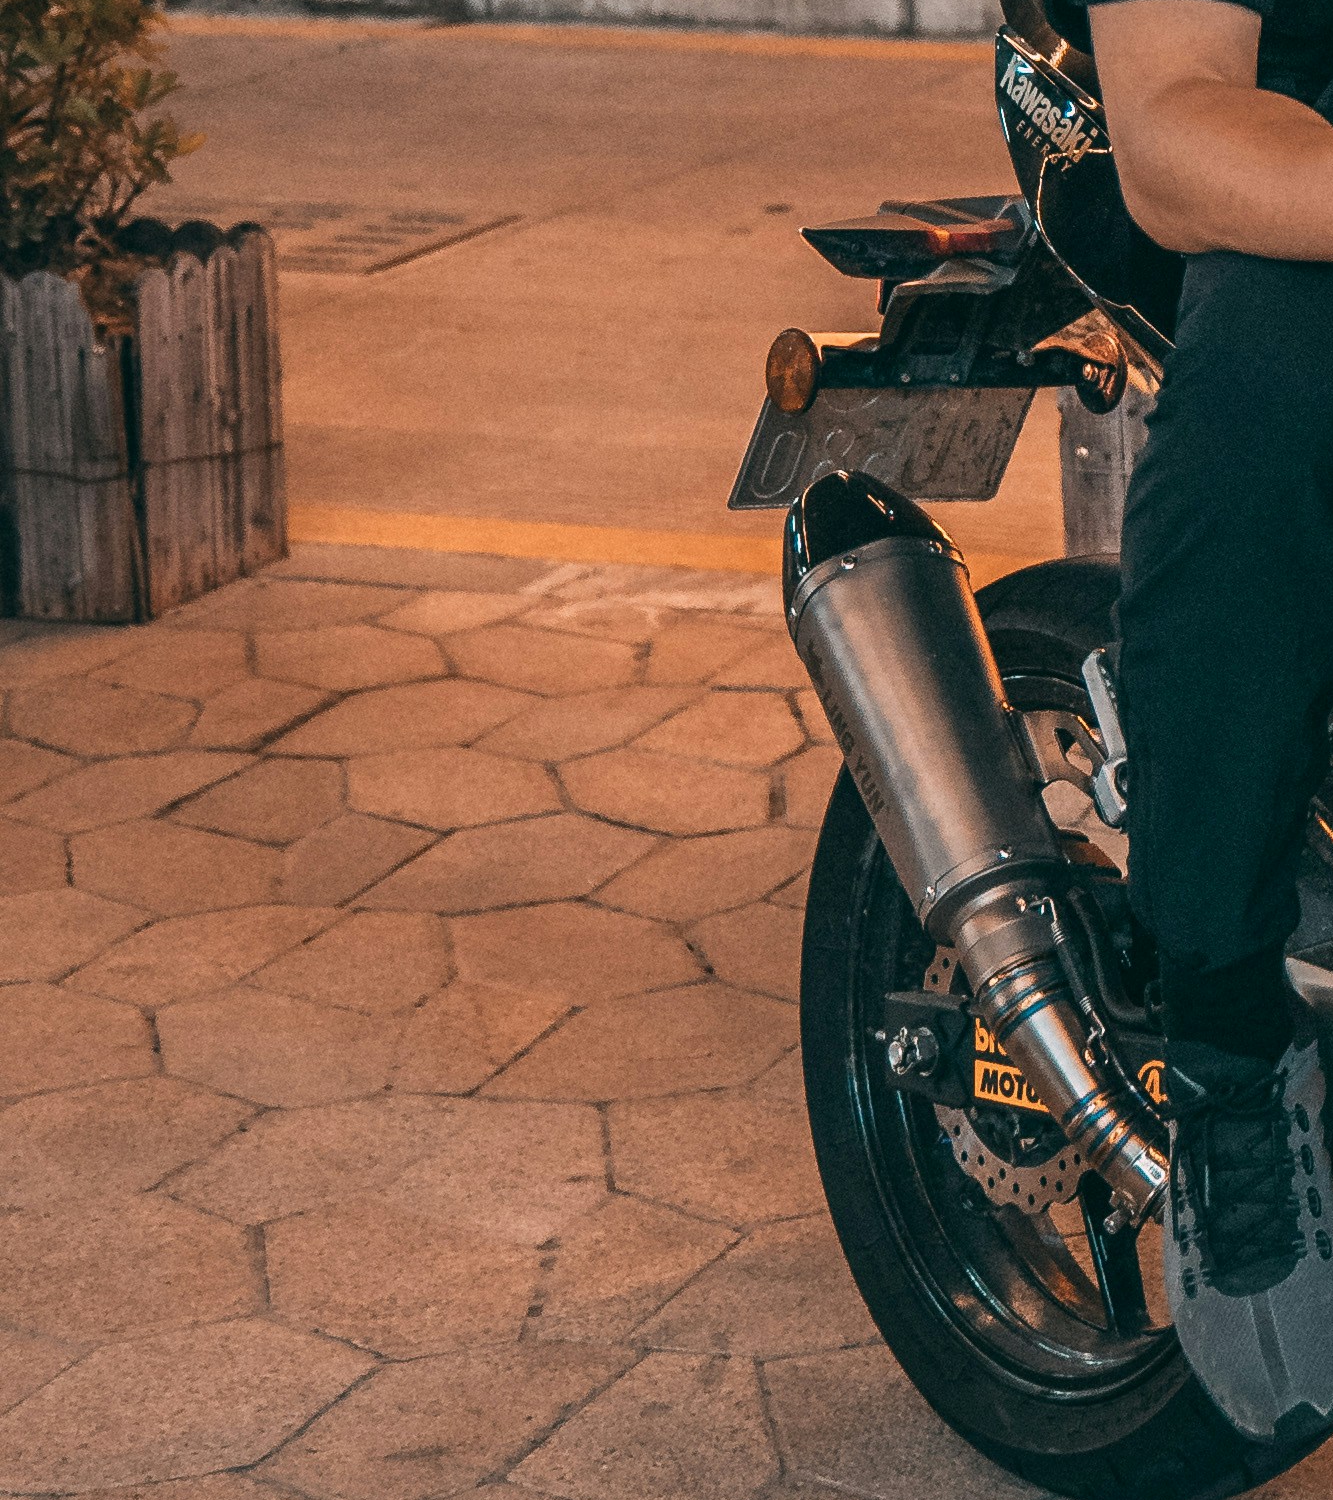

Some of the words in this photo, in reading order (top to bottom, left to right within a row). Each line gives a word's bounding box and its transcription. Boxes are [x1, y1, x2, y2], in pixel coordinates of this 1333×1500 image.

[1000, 52, 1099, 164] Kawasaki
[1015, 119, 1073, 173] ENERGY
[855, 753, 886, 816] YUN
